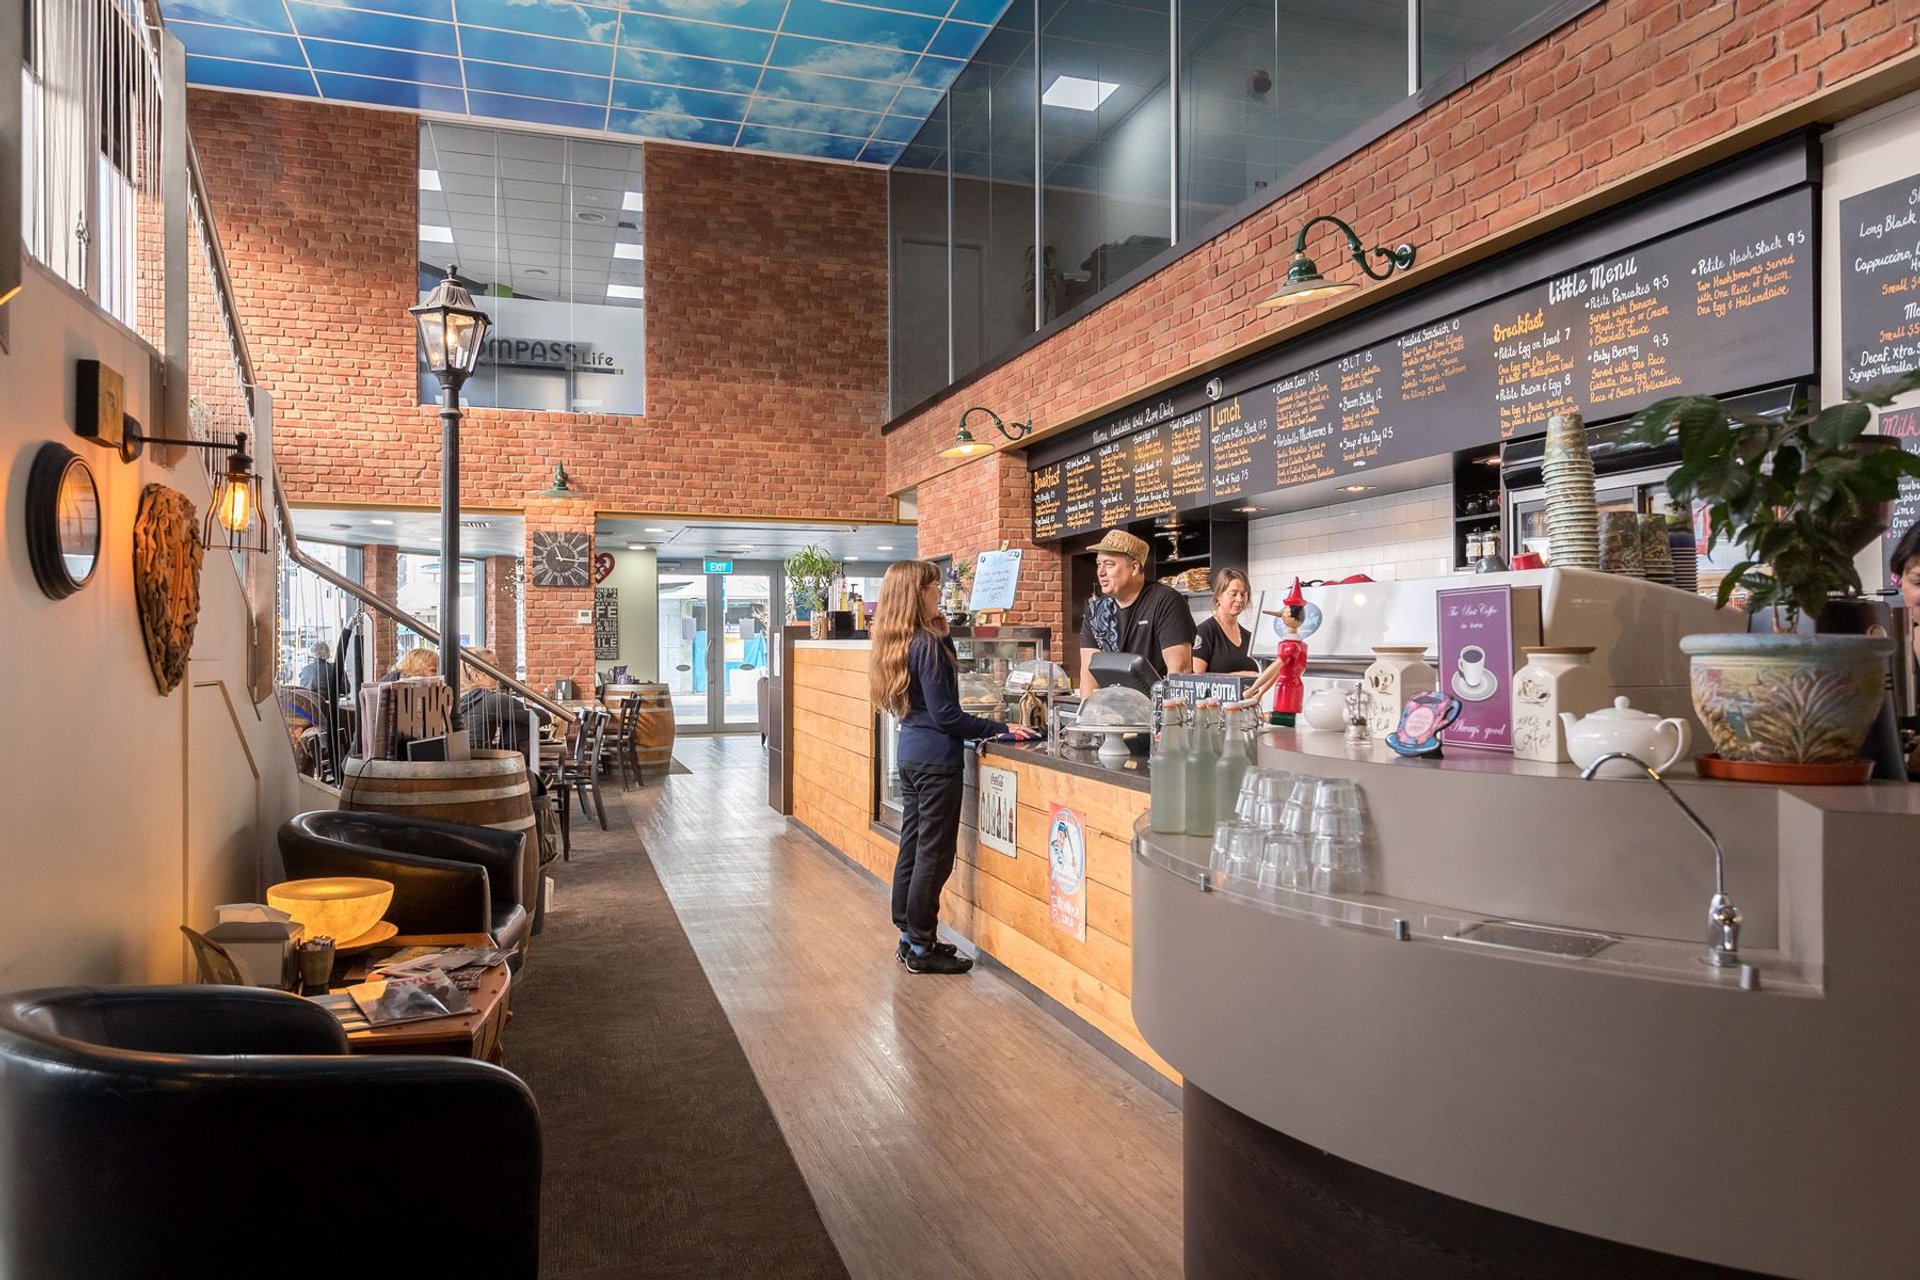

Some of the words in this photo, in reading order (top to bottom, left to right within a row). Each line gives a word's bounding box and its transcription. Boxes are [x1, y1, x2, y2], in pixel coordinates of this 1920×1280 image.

[1860, 222, 1882, 238] Long
[1885, 209, 1917, 232] Black
[1698, 255, 1725, 276] Petite
[1730, 245, 1754, 266] Hash
[1755, 235, 1783, 256] Stack
[1766, 252, 1796, 271] Served
[1855, 248, 1913, 274] Cappuccino,
[1590, 257, 1638, 290] Menu
[1591, 296, 1611, 310] Petite
[1612, 282, 1650, 303] Pancakes
[1697, 292, 1713, 304] with
[1714, 288, 1730, 299] One
[1731, 283, 1751, 297] Piece
[1753, 275, 1762, 288] of
[1881, 278, 1909, 295] Small
[1697, 306, 1711, 316] One
[1713, 301, 1726, 318] Egg
[1736, 284, 1789, 309] Hollandaise
[1494, 307, 1544, 343] Breakfast
[1590, 309, 1611, 324] Served
[1402, 332, 1421, 349] Toasted
[1422, 322, 1451, 341] Sandwich
[1453, 319, 1460, 330] 10
[1498, 347, 1518, 360] Petite
[1519, 341, 1532, 359] Egg
[1532, 342, 1541, 351] on
[1565, 328, 1572, 340] 7
[1879, 326, 1906, 343] Small
[582, 352, 614, 367] Life
[1365, 350, 1372, 363] 15
[1593, 350, 1611, 365] Baby
[1611, 344, 1640, 360] Benny
[1892, 345, 1916, 360] Xtra
[1591, 367, 1613, 379] Served
[1499, 389, 1518, 401] Petite
[1520, 382, 1542, 398] Bacon
[1549, 379, 1562, 397] Egg
[1564, 374, 1571, 386] 8
[1211, 397, 1241, 432] Lunch
[1343, 396, 1358, 412] Bacon
[1882, 412, 1920, 438] Milk
[1343, 437, 1356, 451] Soup
[1371, 430, 1382, 447] Day
[710, 562, 726, 571] EXIT
[1211, 683, 1237, 701] GOTTA
[397, 685, 454, 739] NEWS
[1484, 723, 1506, 740] good
